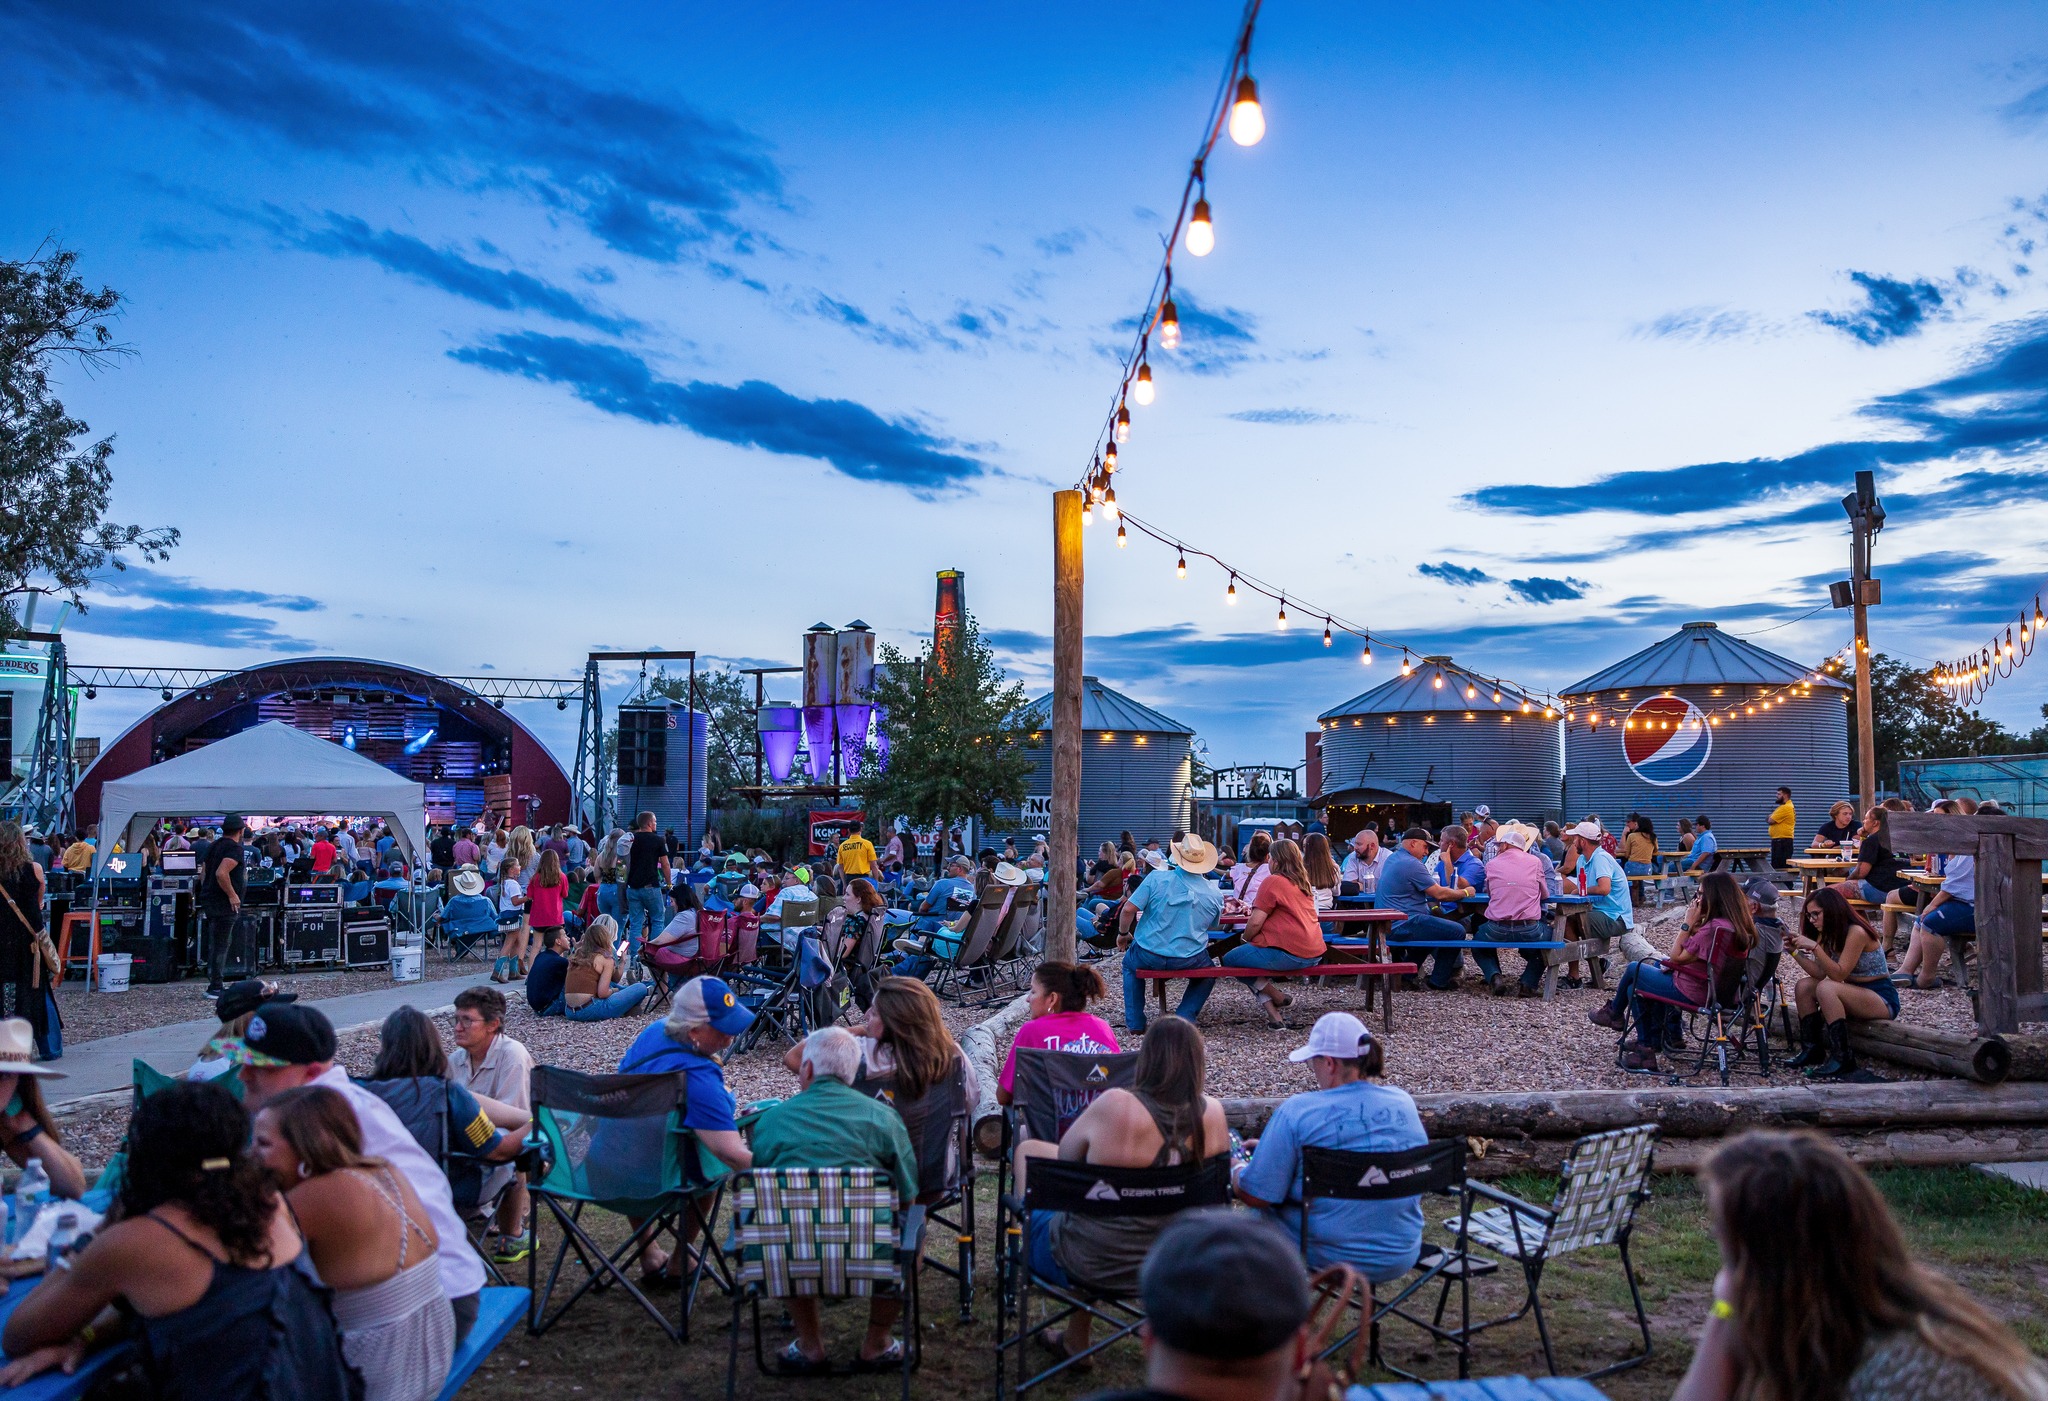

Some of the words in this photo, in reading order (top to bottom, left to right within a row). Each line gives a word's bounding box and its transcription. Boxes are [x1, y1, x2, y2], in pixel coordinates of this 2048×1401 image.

[842, 842, 863, 851] SECURITY
[302, 922, 324, 931] FOH
[309, 950, 316, 959] 2
[1121, 1188, 1156, 1197] OZARK
[1157, 1185, 1185, 1196] TRAIL
